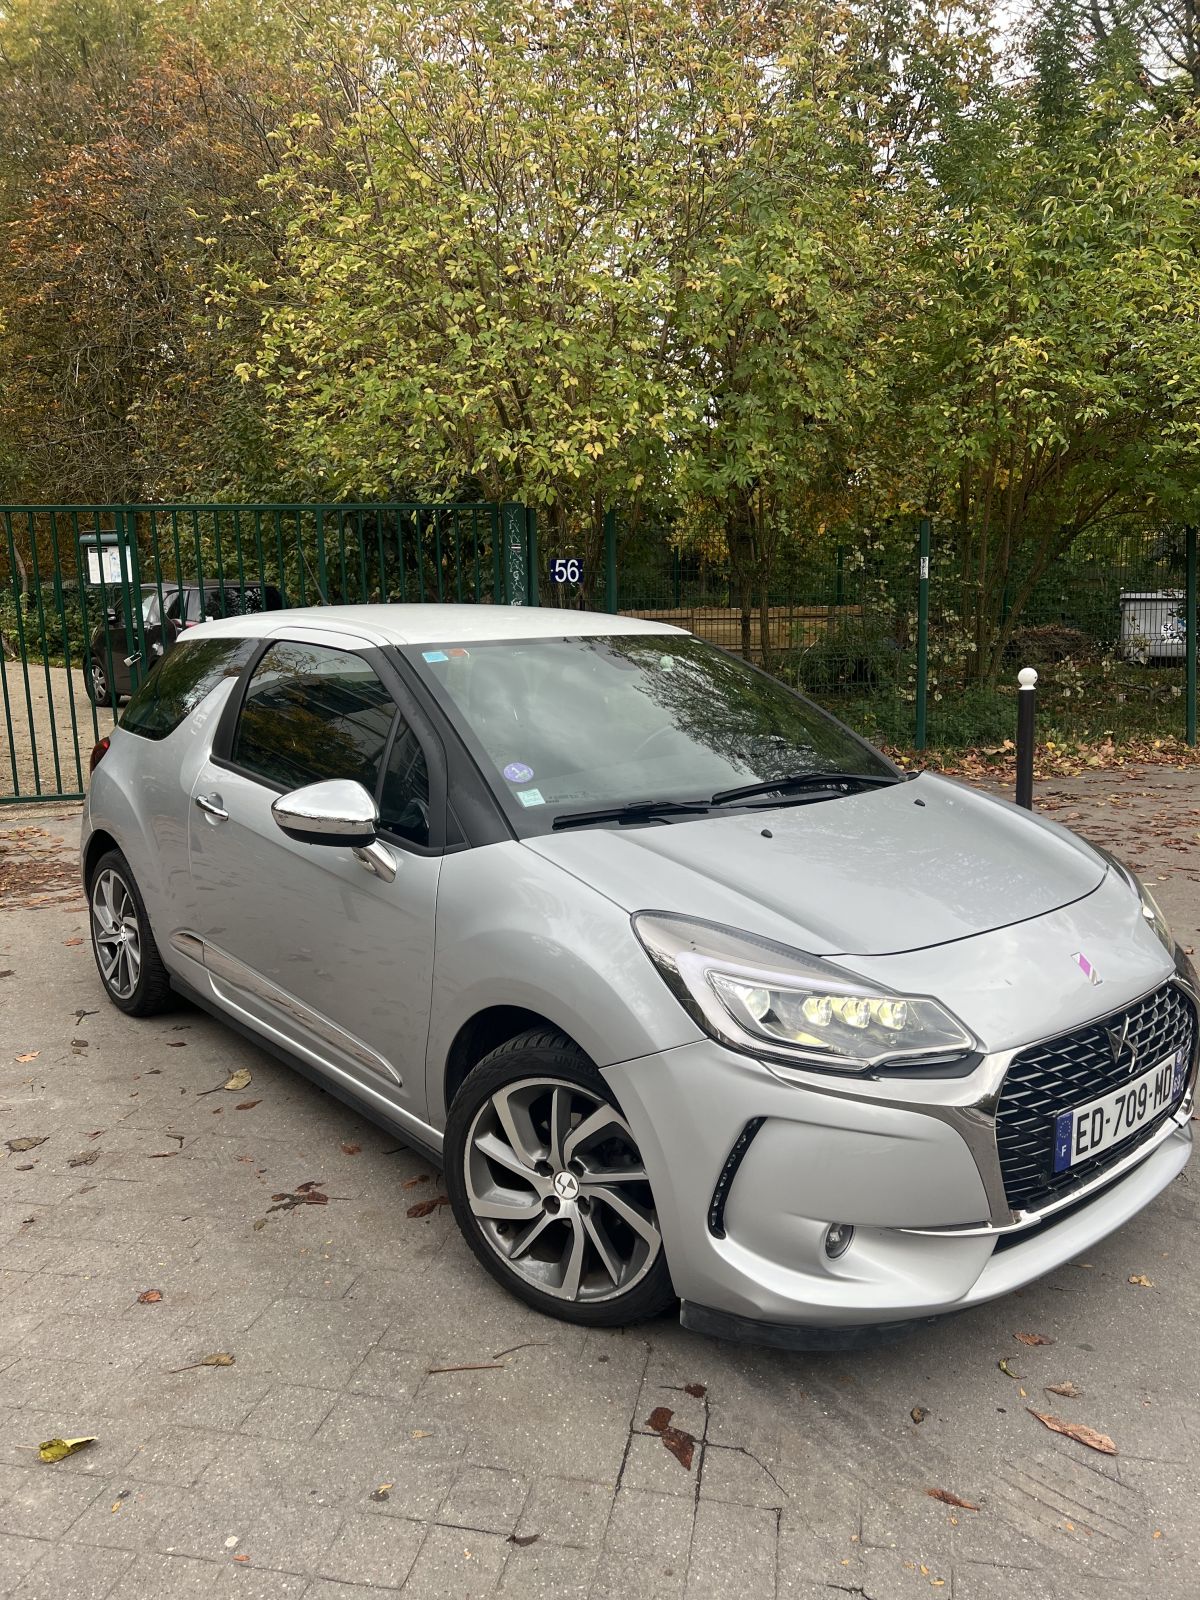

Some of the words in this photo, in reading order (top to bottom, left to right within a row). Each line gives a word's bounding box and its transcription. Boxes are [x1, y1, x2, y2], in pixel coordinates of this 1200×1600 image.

[555, 559, 579, 583] 56
[1075, 1063, 1173, 1156] ED-709-MD
[1061, 1145, 1067, 1157] F
